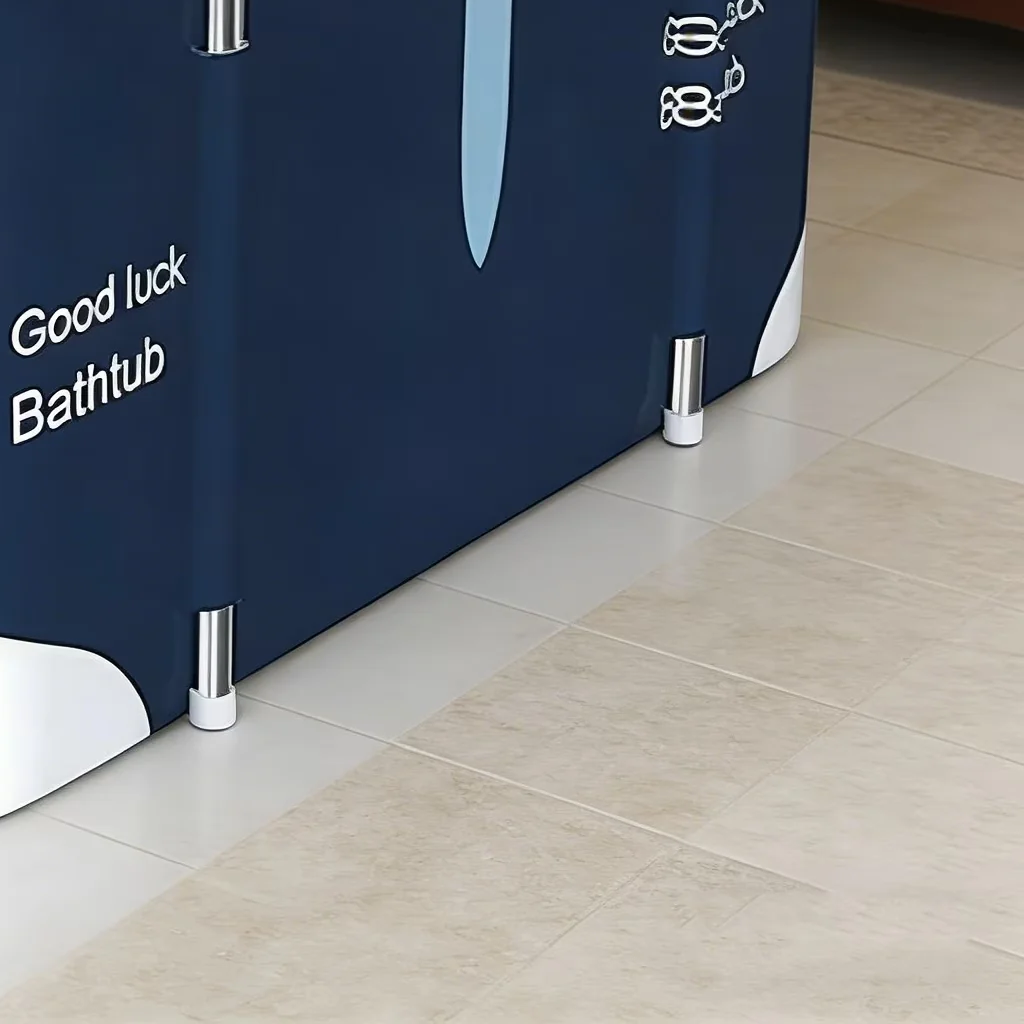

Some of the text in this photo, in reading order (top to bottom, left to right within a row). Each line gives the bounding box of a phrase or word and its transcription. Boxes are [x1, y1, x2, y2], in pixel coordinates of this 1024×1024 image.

[11, 244, 187, 356] Good luck
[12, 336, 165, 445] Bathtub
